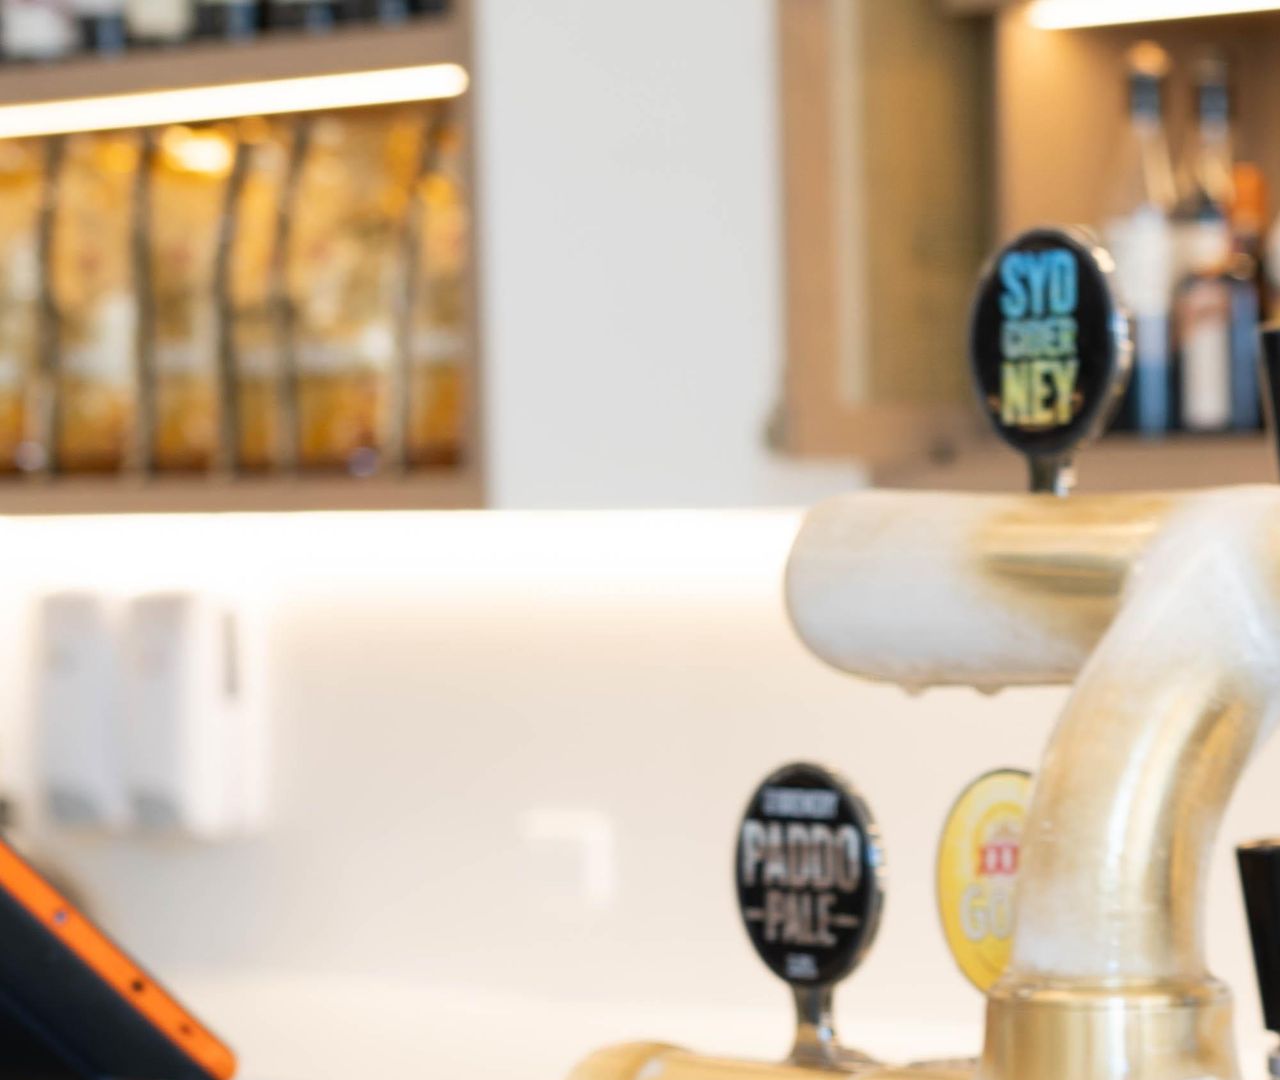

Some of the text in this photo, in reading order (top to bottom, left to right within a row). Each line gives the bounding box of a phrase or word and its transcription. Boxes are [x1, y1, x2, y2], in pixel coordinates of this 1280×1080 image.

[1001, 358, 1081, 427] NEY
[742, 819, 862, 893] PADDO
[763, 889, 838, 947] PALE
